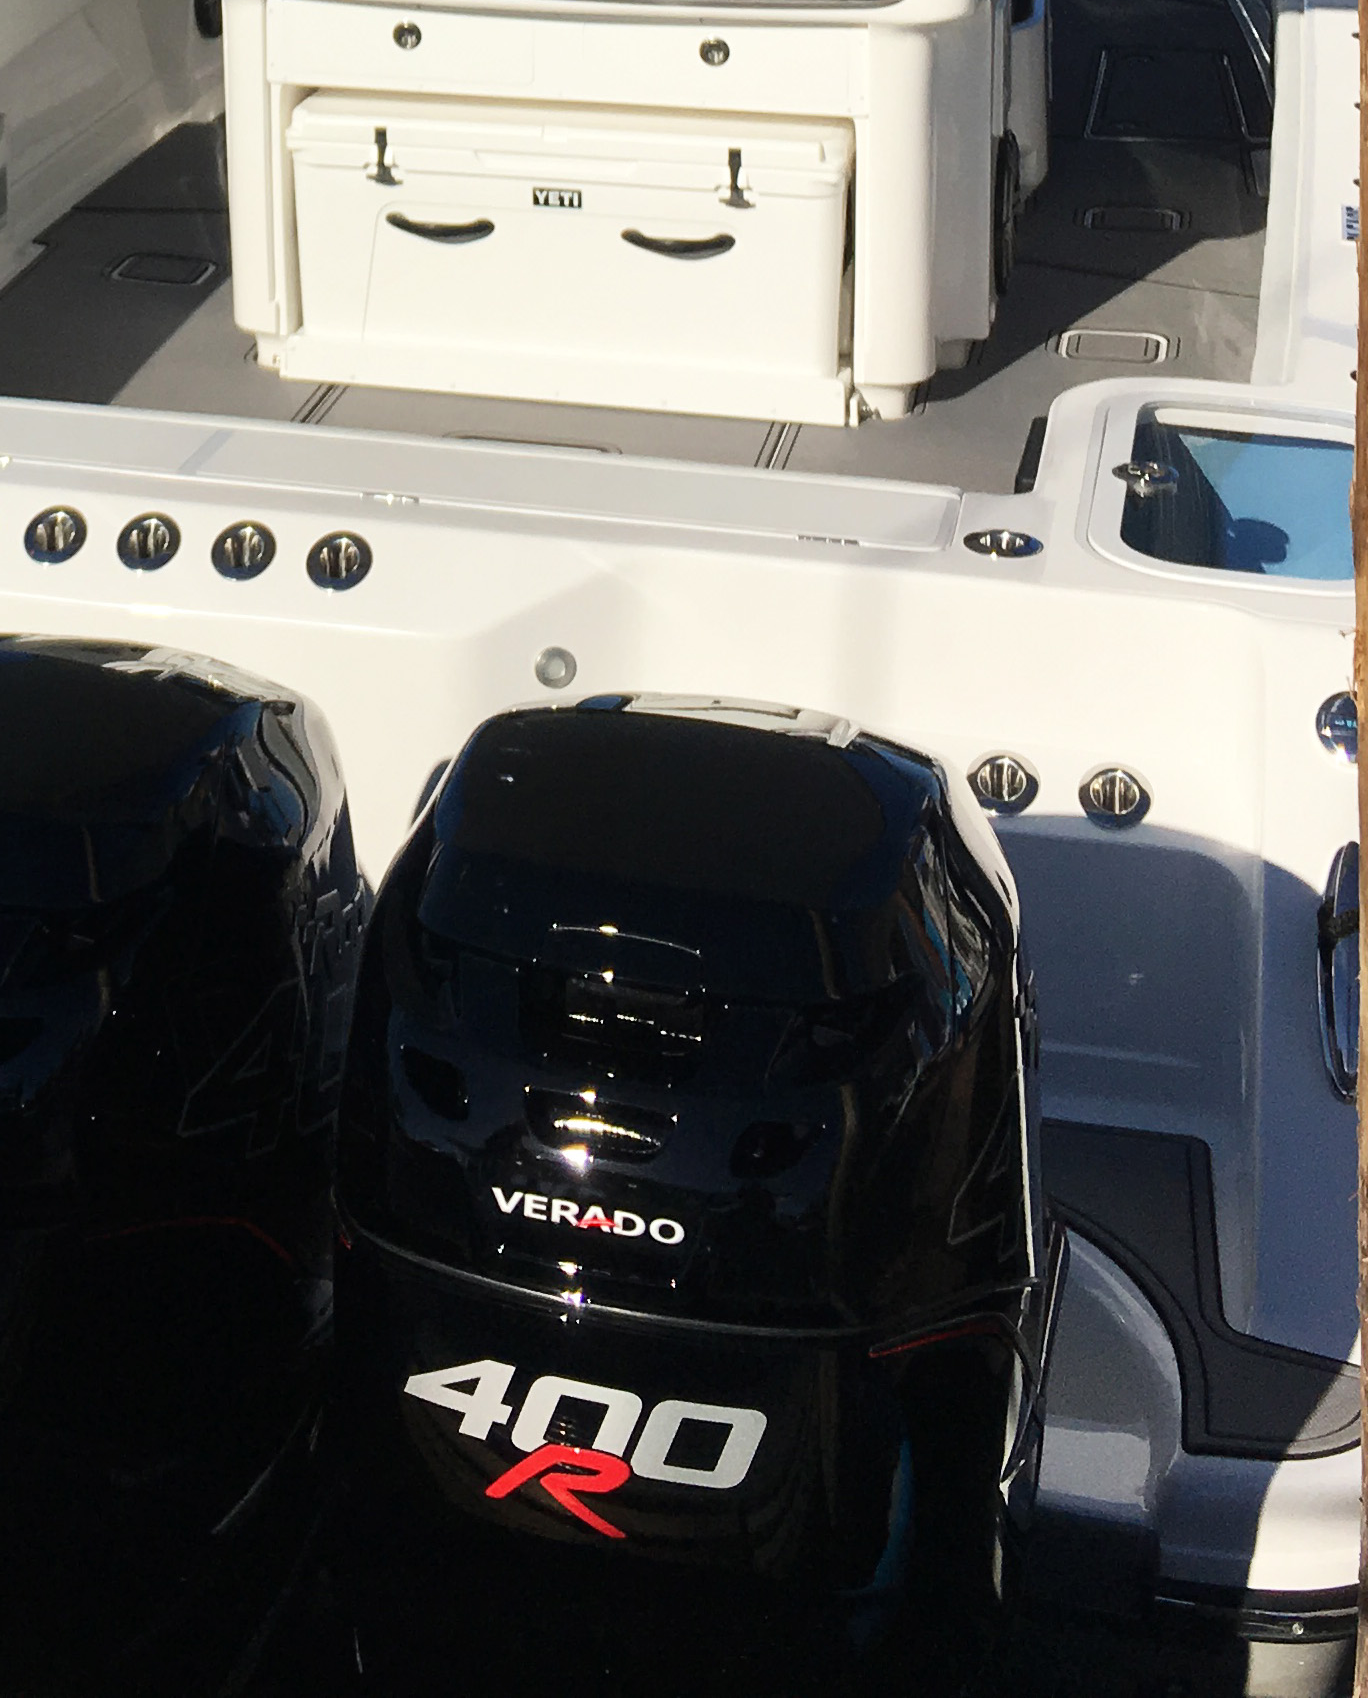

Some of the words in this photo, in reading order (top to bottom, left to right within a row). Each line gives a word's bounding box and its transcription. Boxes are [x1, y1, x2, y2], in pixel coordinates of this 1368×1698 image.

[535, 189, 579, 207] YETI
[491, 1186, 685, 1245] VERADO
[403, 1359, 768, 1489] 400
[484, 1443, 631, 1539] R
